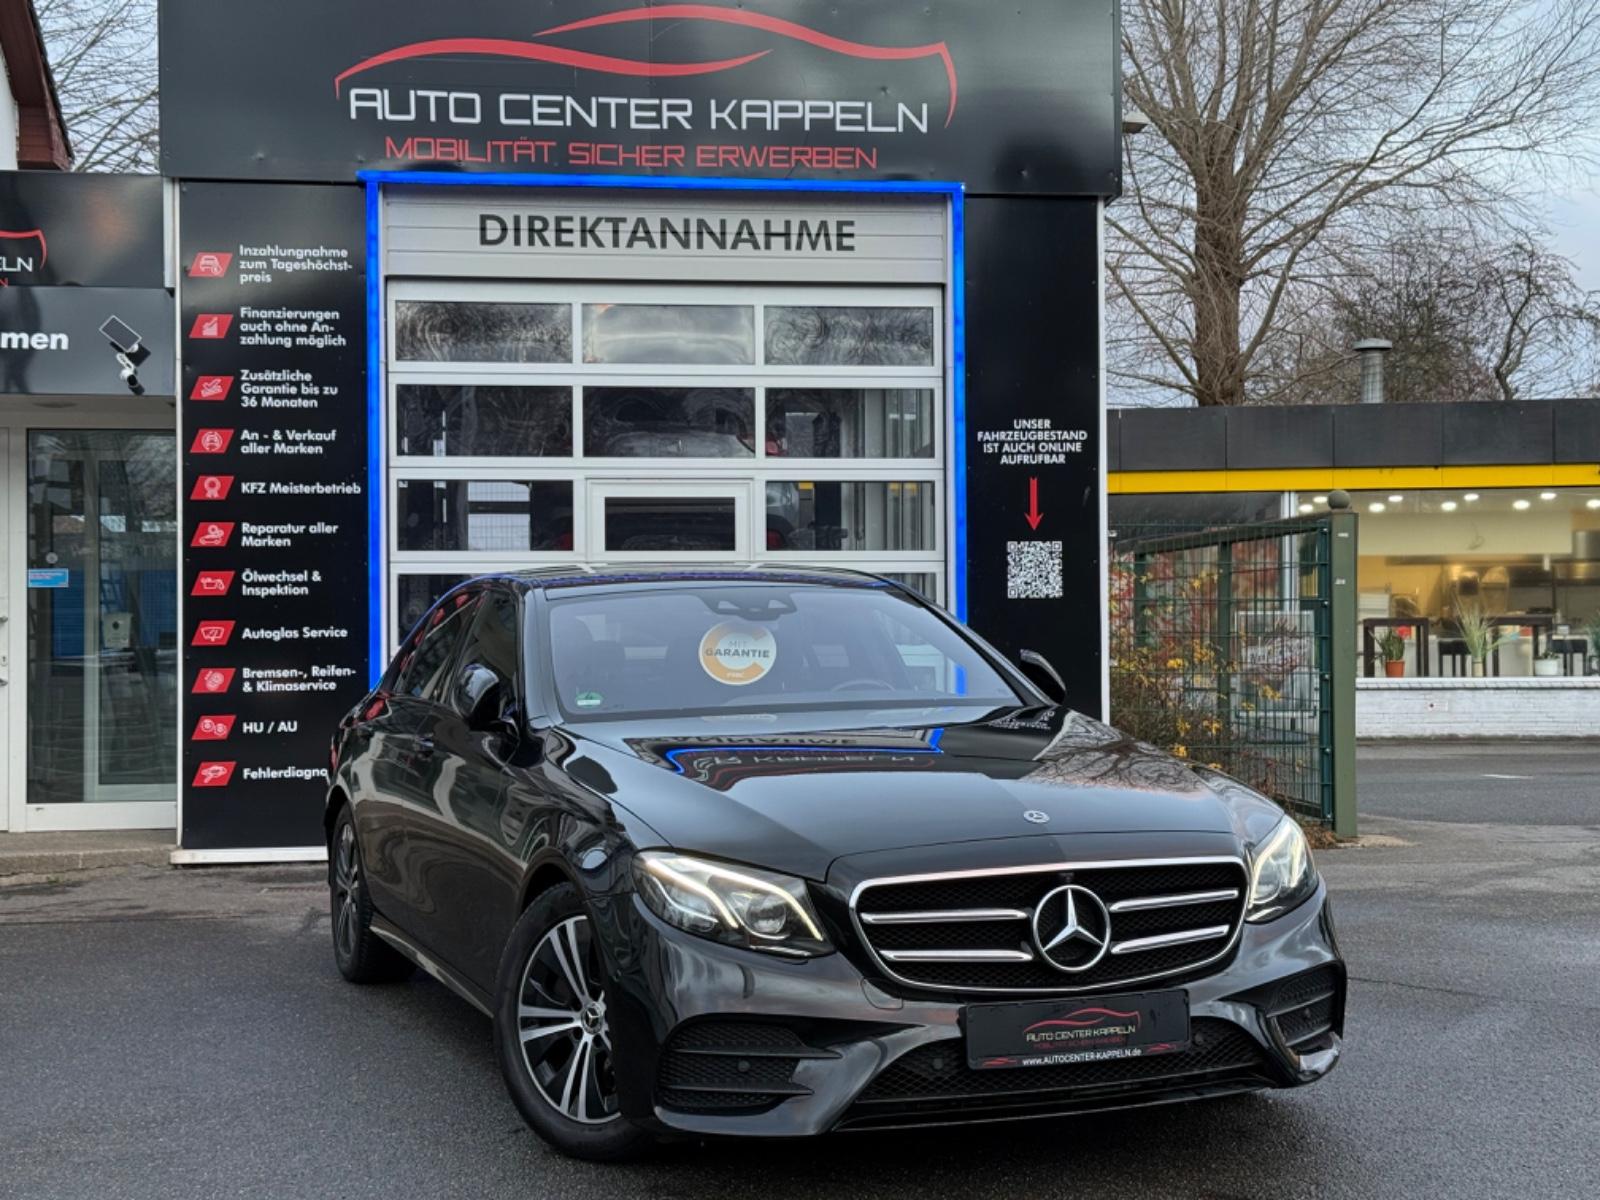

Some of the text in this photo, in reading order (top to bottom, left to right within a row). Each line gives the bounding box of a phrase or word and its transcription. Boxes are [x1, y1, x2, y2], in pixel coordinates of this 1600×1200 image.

[350, 88, 927, 133] AUTO CENTER KAPPELN
[385, 136, 877, 168] MOBILITÄT SICHER ERWERBEN
[479, 214, 855, 251] DIREKTANNAHME
[240, 245, 348, 259] Inzahlungnahme
[0, 256, 32, 272] LN
[240, 260, 352, 273] zum Tageshöchst-
[240, 273, 271, 284] preis
[240, 308, 339, 322] Finanzierungen
[240, 321, 334, 332] auch ohne An-
[1, 331, 68, 350] men
[240, 335, 346, 348] zahlung möglich
[240, 370, 312, 381] Zusätzliche
[241, 383, 338, 395] Garantie bis zu
[241, 397, 317, 408] 36 Monaten
[1014, 419, 1051, 429] UNSER
[241, 431, 259, 440] An
[273, 431, 282, 440] &
[286, 430, 336, 441] Verkauf
[978, 431, 1087, 441] FAHRZEUGBESTAND
[241, 443, 322, 454] aller Marken
[984, 442, 1082, 453] IST AUCH ONLINE
[1000, 454, 1065, 464] AUFRUFBAR
[241, 483, 360, 494] KFZ Meisterbetrieb
[242, 523, 338, 535] Reparatur aller
[242, 536, 290, 547] Marken
[242, 568, 321, 582] Ölwechsel &
[242, 585, 308, 598] Inspektion
[242, 627, 347, 641] Autoglas Service
[705, 648, 770, 658] GARANTIE
[243, 666, 356, 679] Bremsen-, Reifen-
[243, 681, 336, 692] & Klimaservice
[243, 722, 263, 732] HU
[277, 721, 297, 732] AU
[1026, 1026, 1135, 1042] AUTO CENTER KAPPELN
